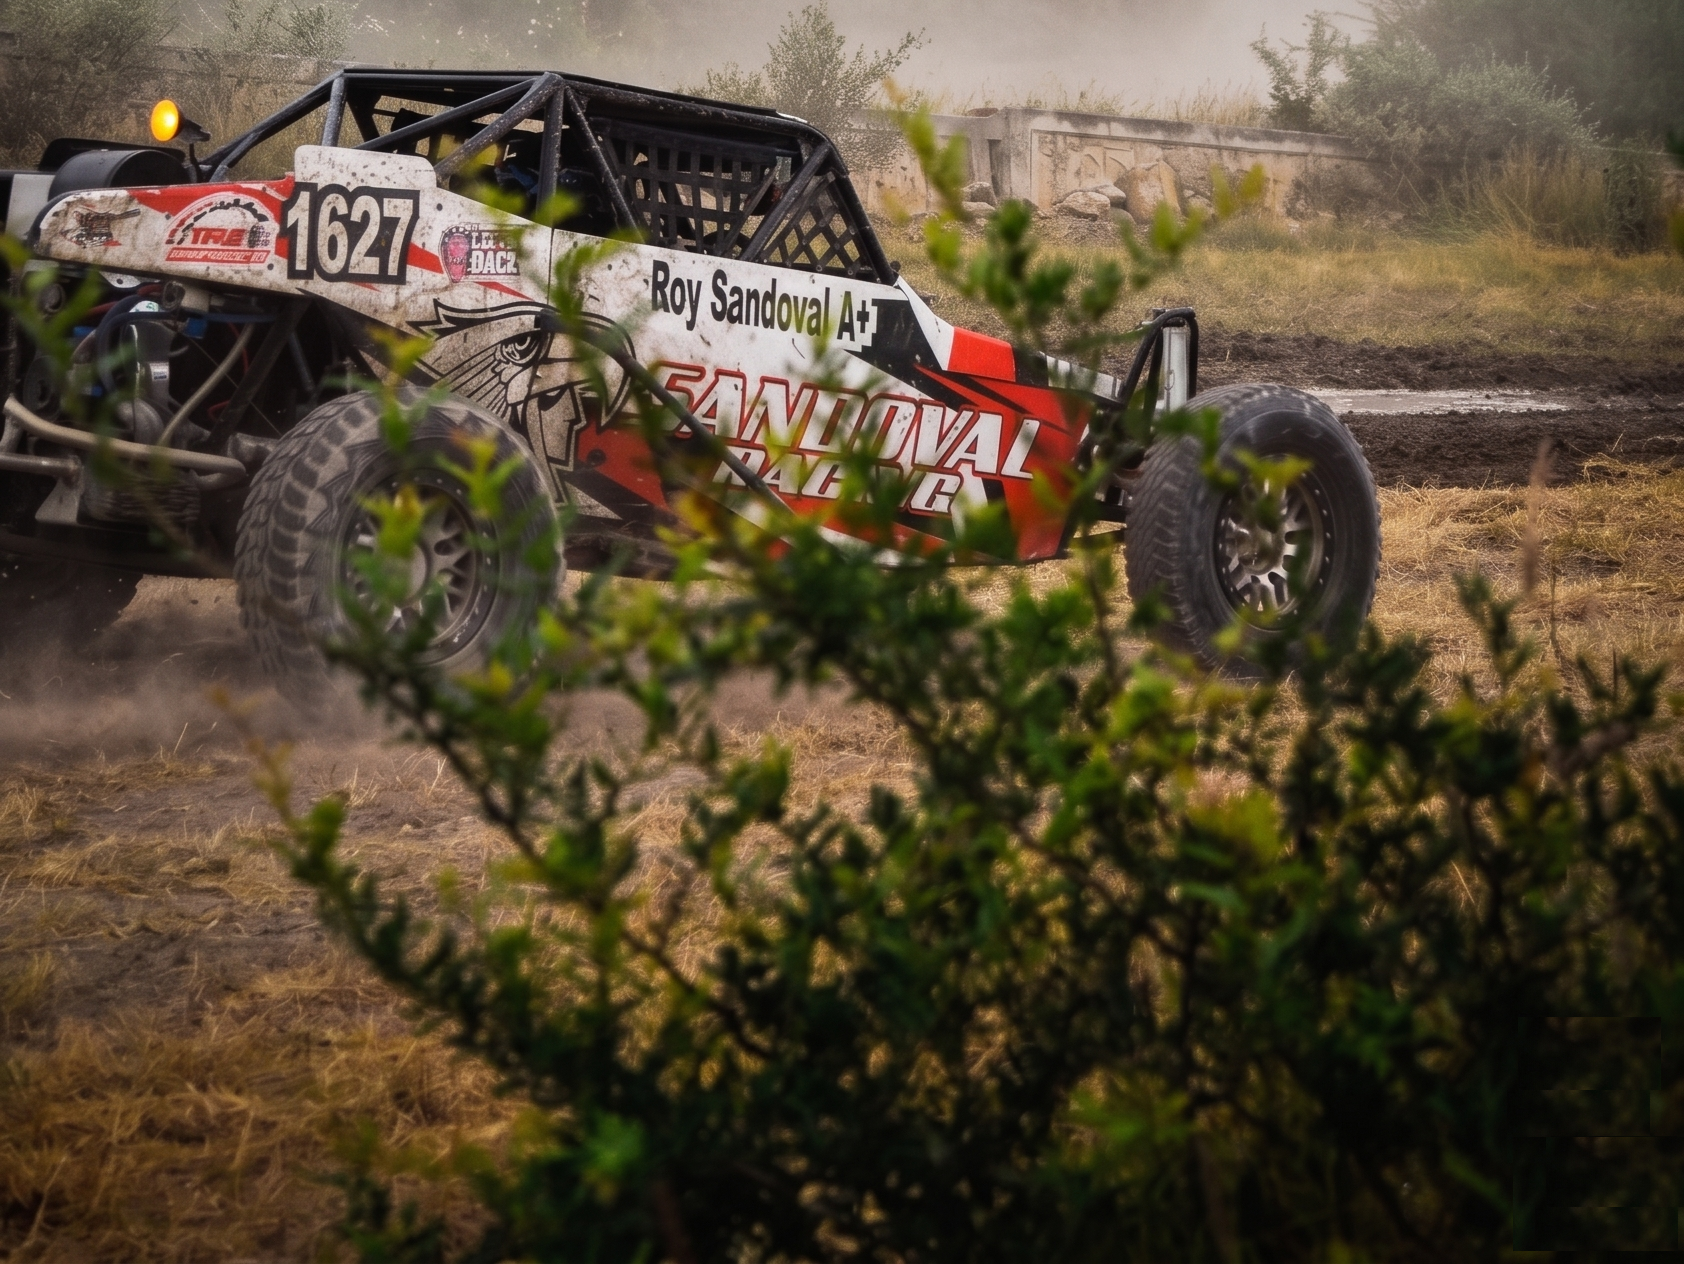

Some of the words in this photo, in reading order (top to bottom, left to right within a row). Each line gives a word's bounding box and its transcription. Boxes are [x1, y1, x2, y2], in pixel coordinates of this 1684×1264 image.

[280, 183, 419, 282] 1627
[651, 259, 702, 332] Roy
[710, 268, 831, 337] Sandoval
[837, 290, 870, 342] A+
[645, 360, 1041, 480] SANDOVAL
